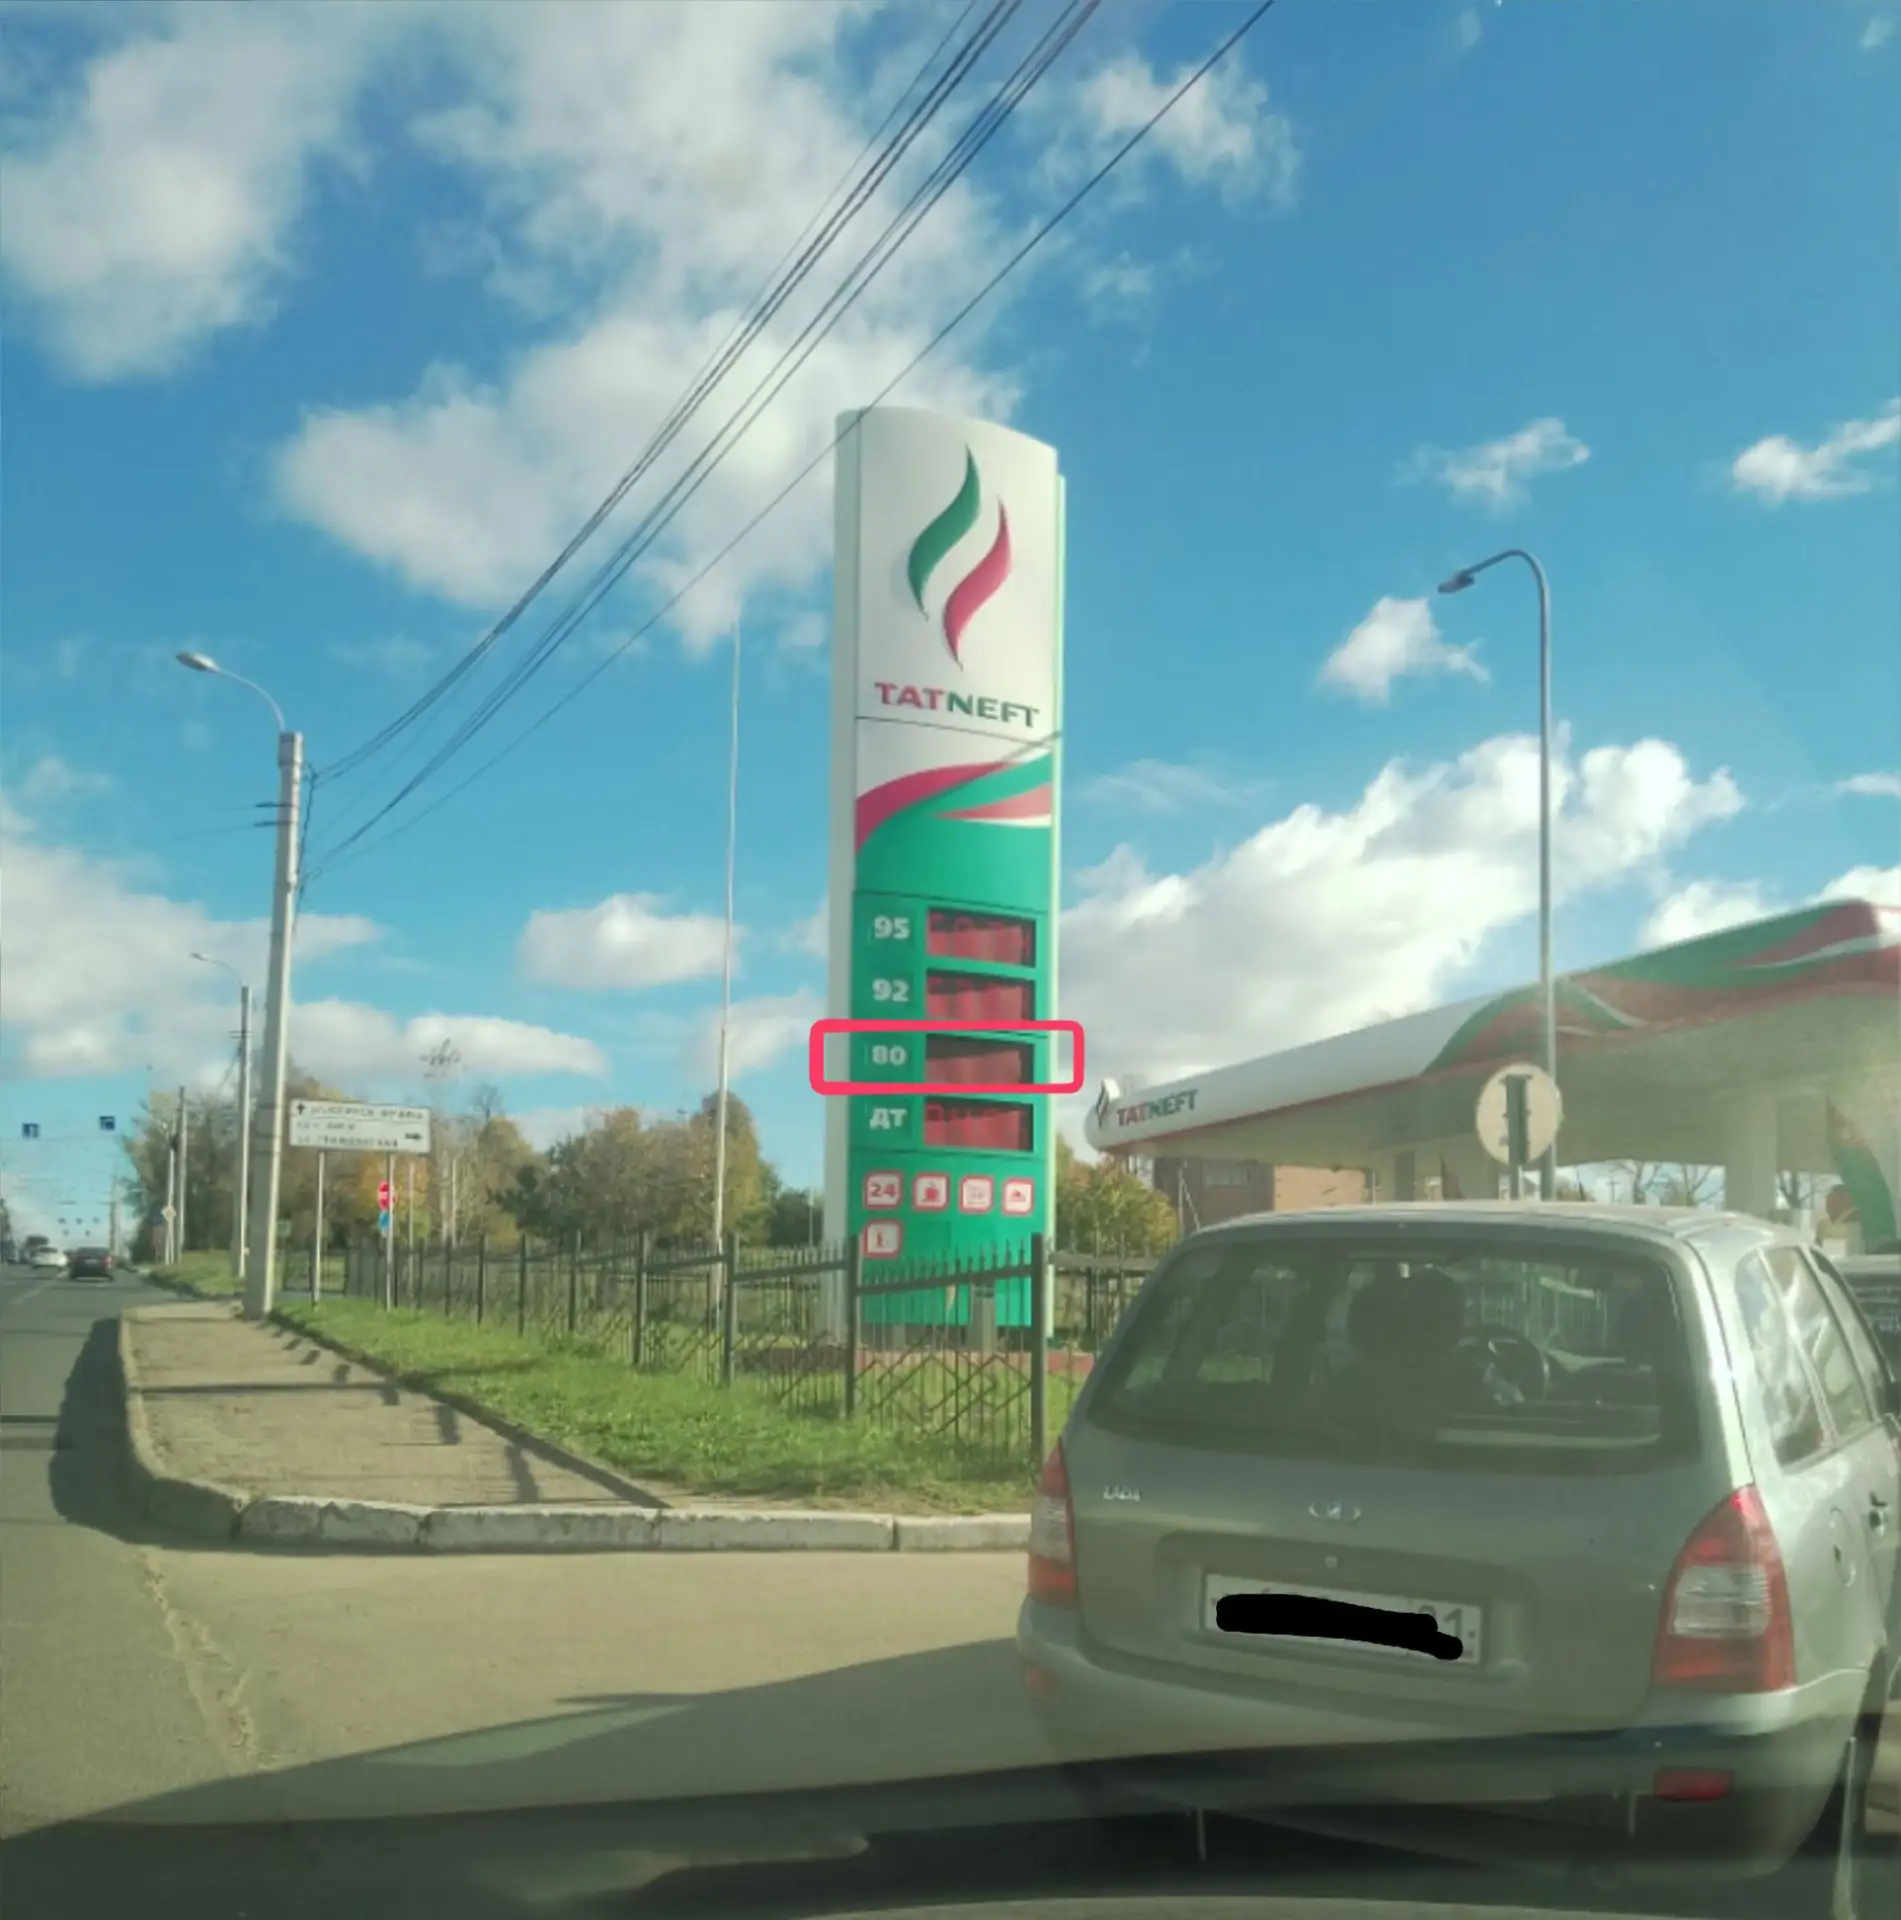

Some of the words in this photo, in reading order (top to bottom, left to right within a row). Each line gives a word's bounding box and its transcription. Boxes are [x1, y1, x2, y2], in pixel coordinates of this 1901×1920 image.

[874, 681, 1040, 728] TATNEFT
[873, 916, 910, 940] 95
[872, 979, 909, 1002] 92
[871, 1045, 908, 1066] 80
[869, 1108, 908, 1130] ДТ
[1116, 1088, 1199, 1127] TATNEFT
[870, 1182, 897, 1198] 24
